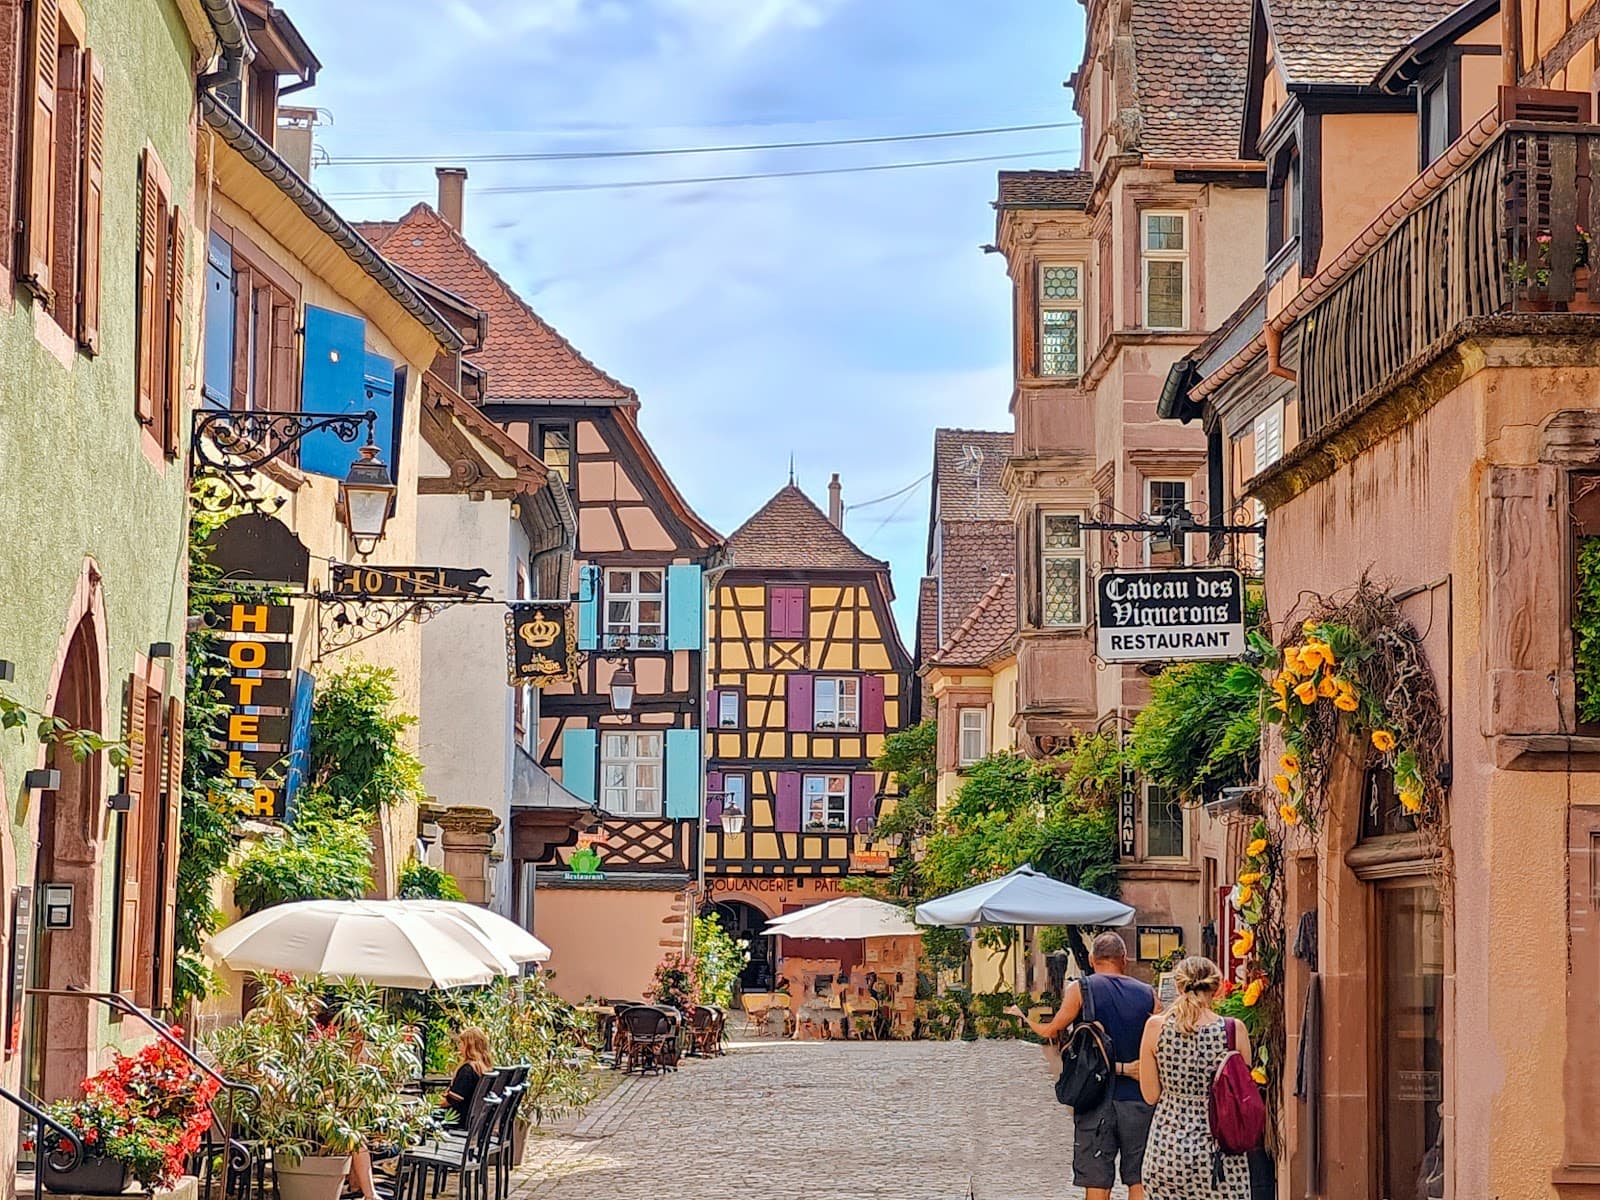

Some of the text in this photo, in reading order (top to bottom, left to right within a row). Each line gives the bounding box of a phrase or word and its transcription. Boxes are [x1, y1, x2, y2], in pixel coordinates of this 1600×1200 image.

[337, 569, 459, 594] HOTEL
[1105, 576, 1233, 601] Caveau des
[1111, 602, 1229, 627] Vignerons
[1111, 631, 1231, 650] RESTAURANT
